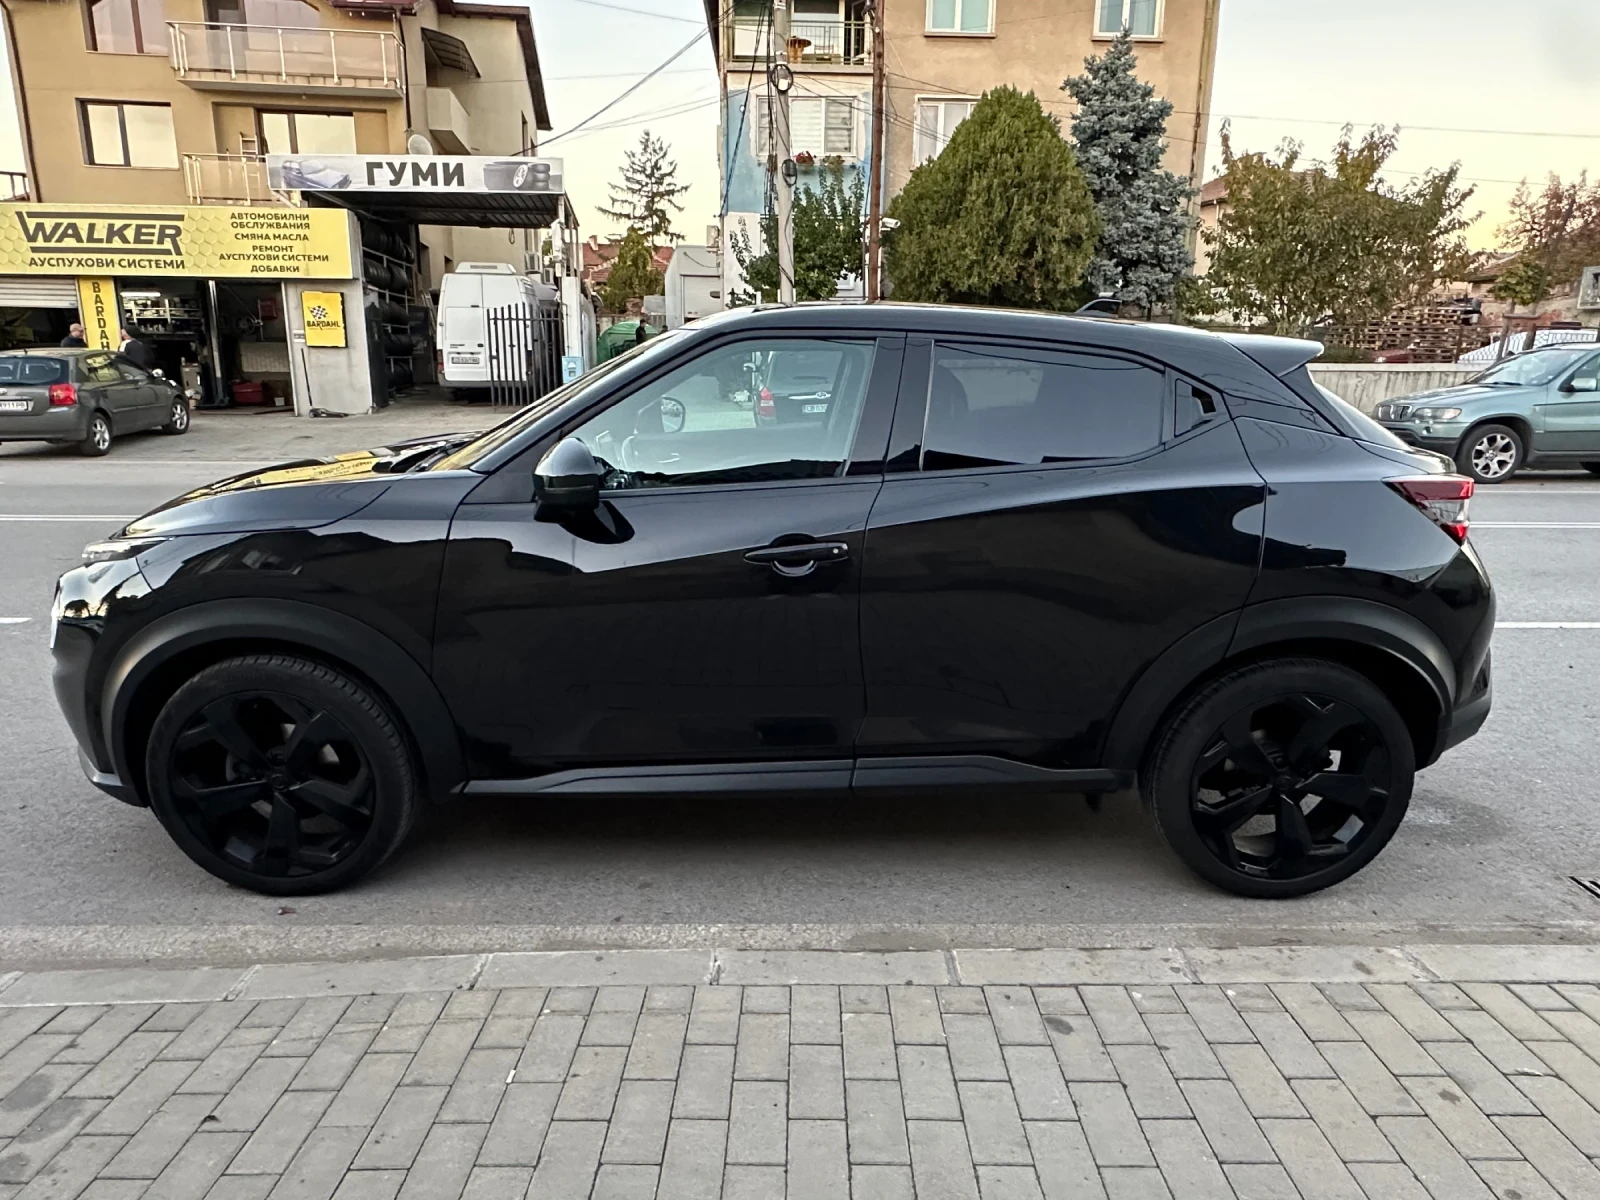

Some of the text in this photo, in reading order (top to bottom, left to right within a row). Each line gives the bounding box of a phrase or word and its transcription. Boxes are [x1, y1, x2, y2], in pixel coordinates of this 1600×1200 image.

[366, 161, 465, 187] ГУМИ
[230, 212, 310, 221] АВТОМОБИЛНИ
[230, 221, 310, 230] ОБСЛУЖВАНИЯ
[15, 211, 185, 256] WALKER
[234, 232, 310, 242] СМЯНА МАСЛА
[252, 245, 294, 253] РЕМОНТ
[219, 253, 329, 262] АУСПУХОВИ СИСТЕМИ
[29, 256, 185, 270] АУСПУХОВИ СИСТЕМИ
[250, 264, 300, 273] ДОБАВКИ
[92, 281, 111, 350] BARDAH
[306, 320, 341, 329] BARDAHL
